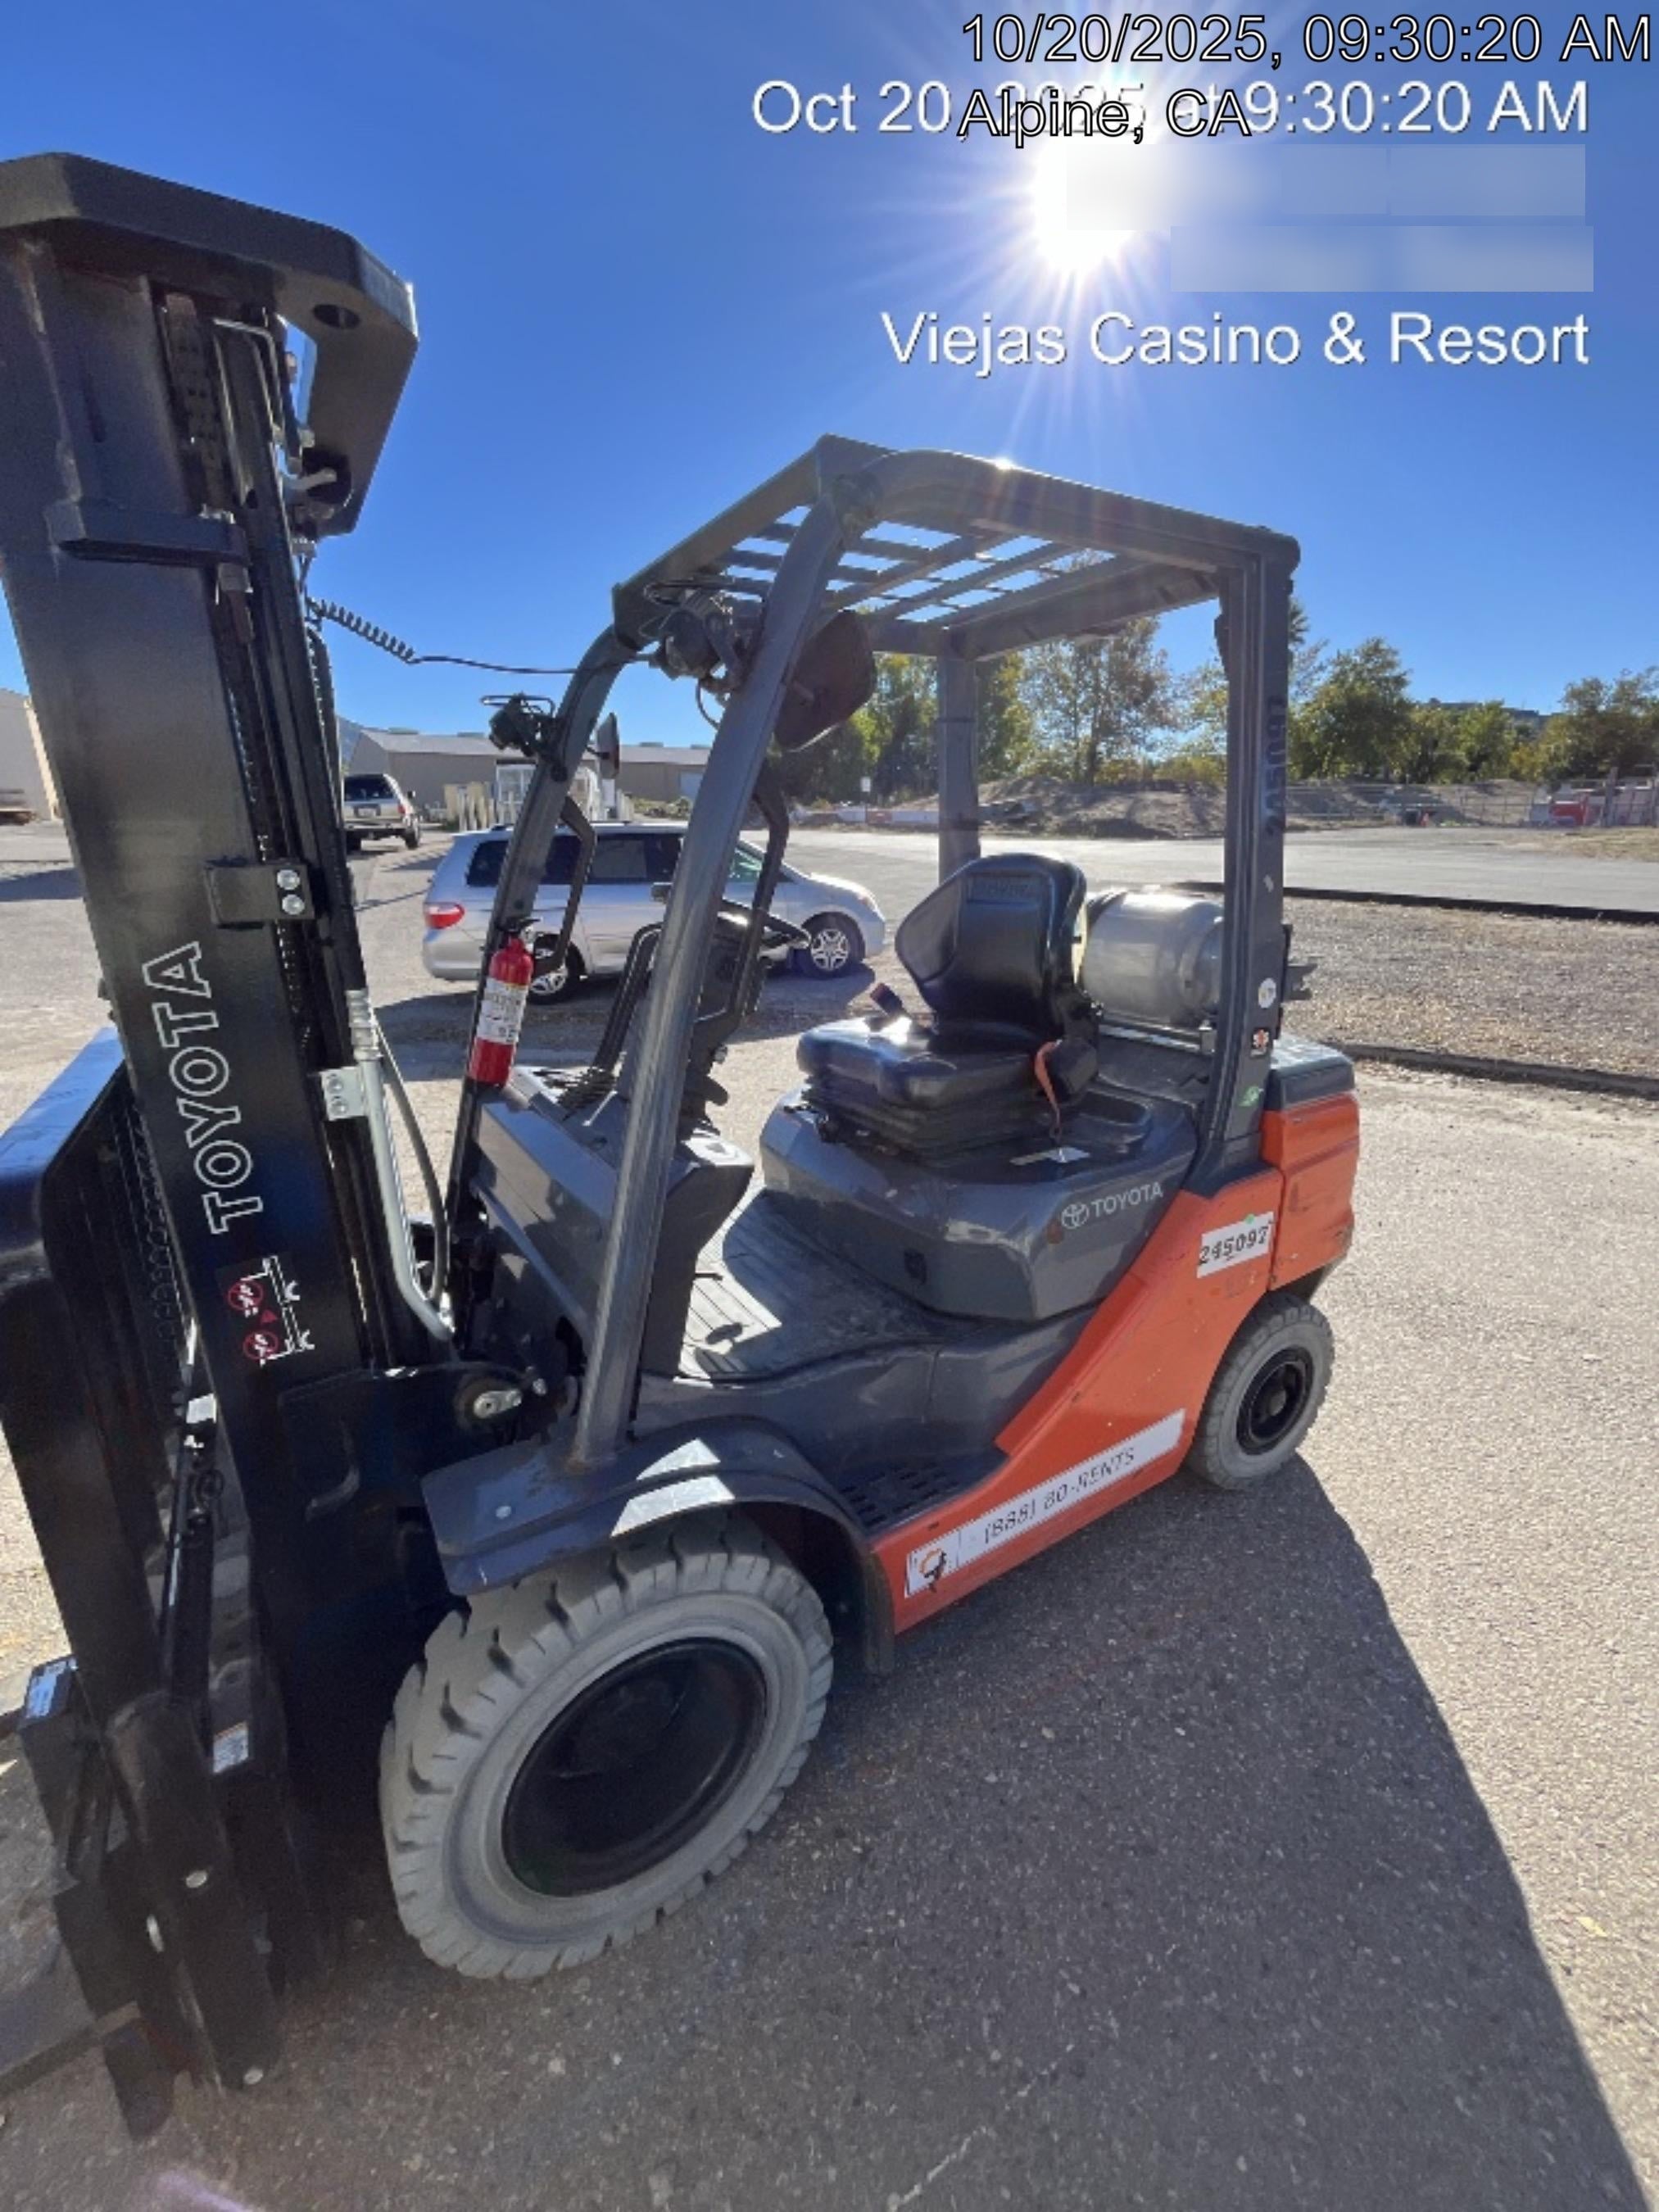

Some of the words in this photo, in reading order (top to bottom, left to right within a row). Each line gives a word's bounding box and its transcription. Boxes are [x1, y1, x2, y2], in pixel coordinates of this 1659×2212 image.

[143, 941, 263, 1235] TOYOTA
[1090, 1181, 1163, 1218] TOYOTA
[1199, 1226, 1269, 1265] 245097
